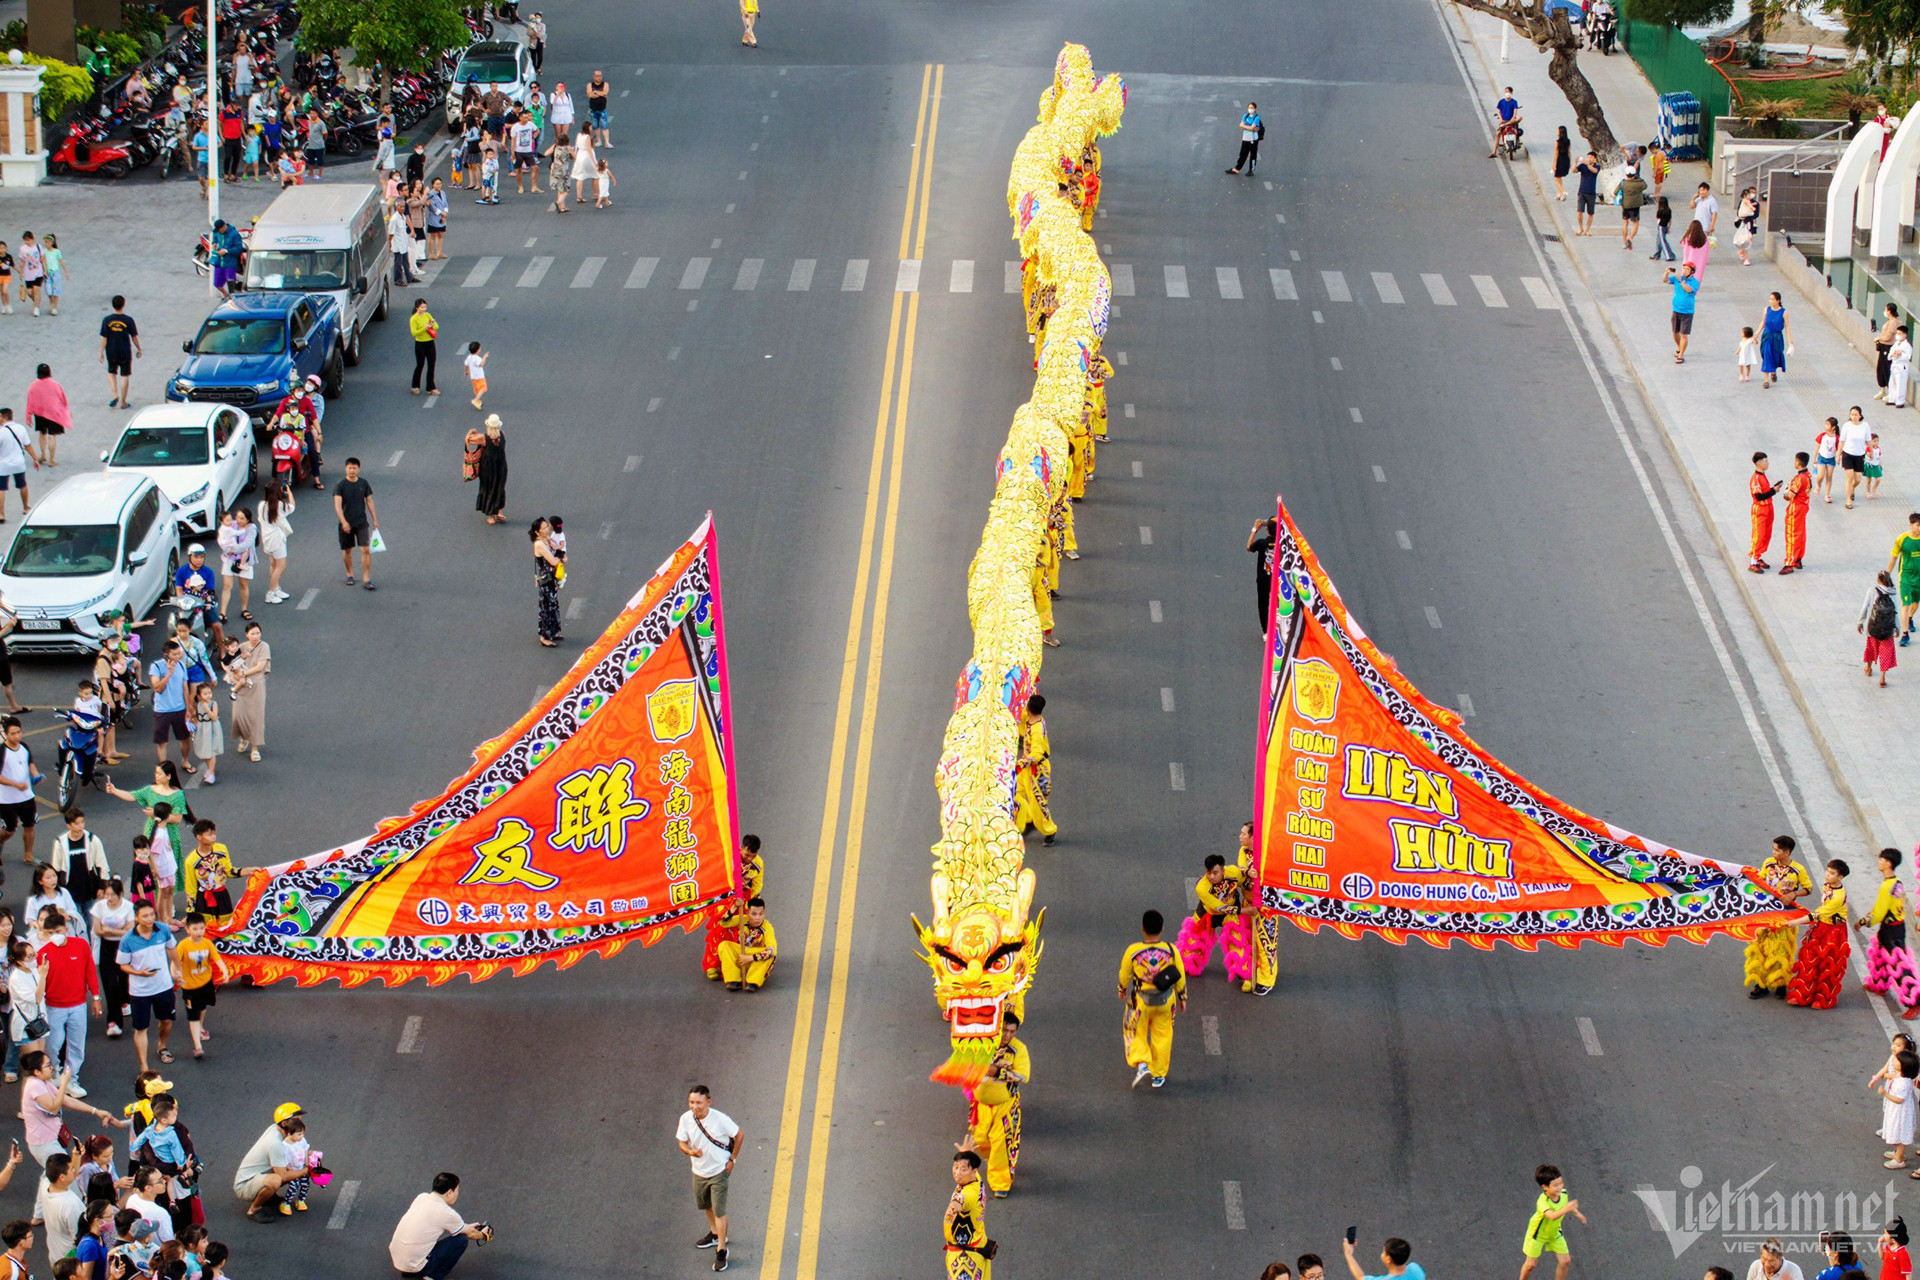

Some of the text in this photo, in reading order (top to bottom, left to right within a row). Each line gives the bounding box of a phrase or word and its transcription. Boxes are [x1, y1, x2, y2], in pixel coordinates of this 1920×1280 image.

[1292, 729, 1336, 755] ĐOÀN
[1297, 759, 1327, 782] LÂN
[1300, 788, 1324, 810] SƯ
[1288, 811, 1333, 840] RỒNG
[1295, 844, 1323, 866] HAI
[1291, 870, 1328, 890] NAM
[1381, 882, 1422, 897] DONG
[1426, 885, 1467, 900] HUNG
[1498, 881, 1518, 898] Ltd
